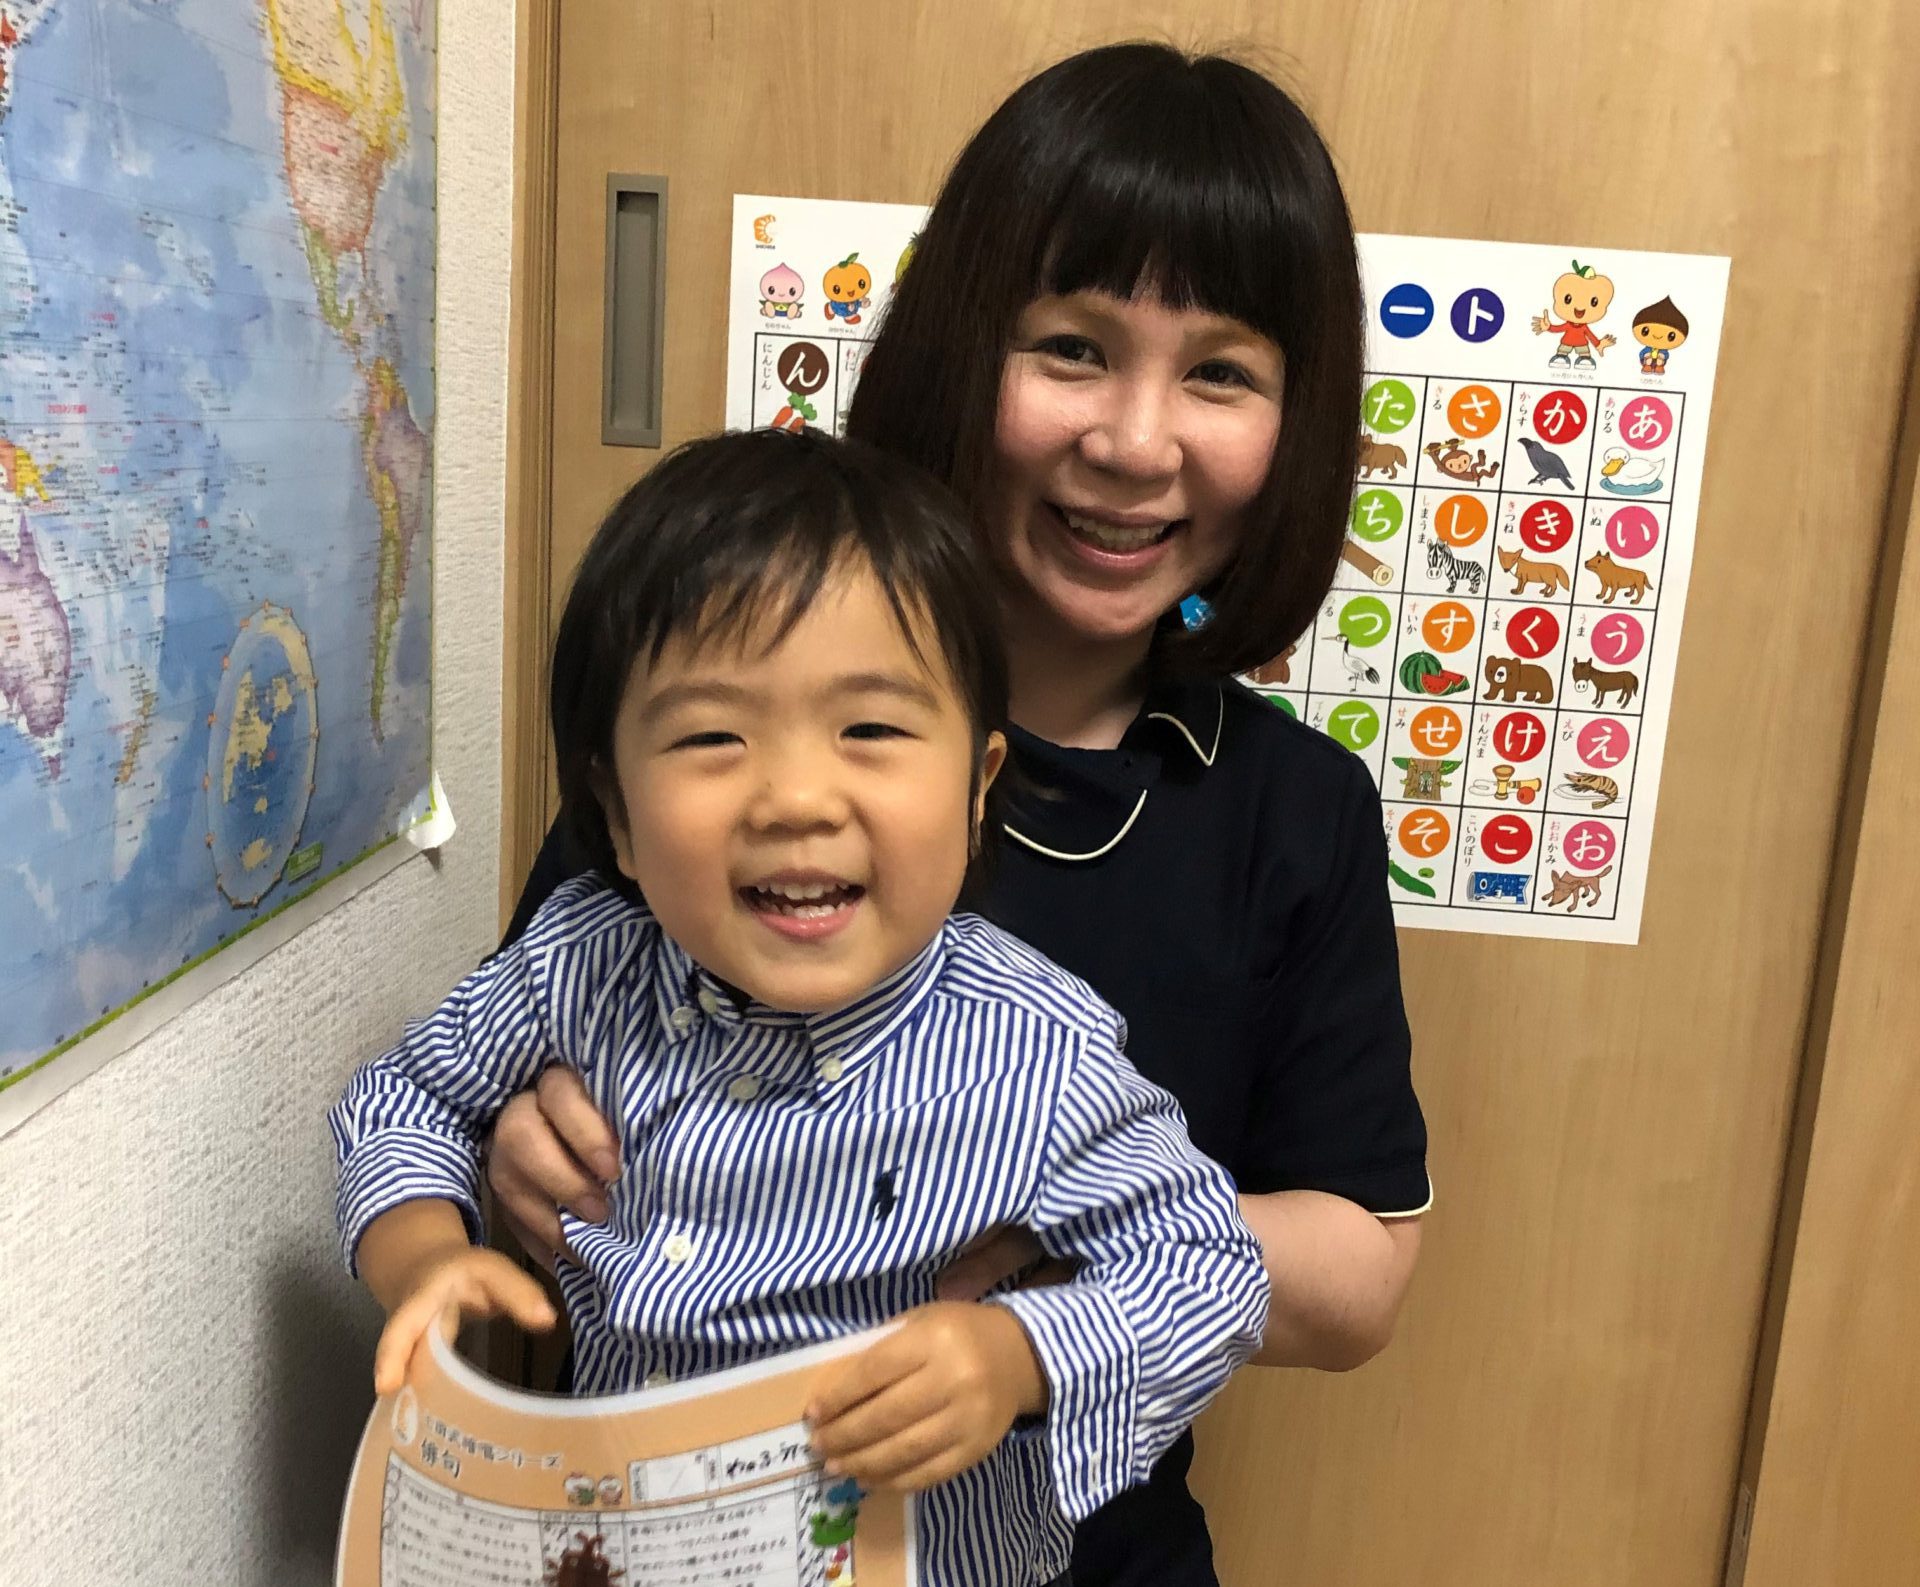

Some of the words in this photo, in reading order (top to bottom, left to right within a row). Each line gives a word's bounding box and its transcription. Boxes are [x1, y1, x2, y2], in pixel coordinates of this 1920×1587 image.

[762, 343, 772, 390] にんじん
[786, 352, 821, 387] ん
[1373, 389, 1404, 425] た
[1460, 394, 1491, 432] さ
[1517, 392, 1530, 427] からす
[1543, 399, 1581, 437] か
[1603, 397, 1615, 433] あひる
[1629, 405, 1662, 443] あ
[1363, 498, 1390, 534] ち
[1417, 495, 1429, 544] しまうま
[1451, 503, 1476, 540] し
[1504, 501, 1515, 533] きつね
[1536, 509, 1559, 546] き
[1590, 508, 1602, 526] いぬ
[1617, 520, 1650, 548] い
[1350, 614, 1382, 634] つ
[1407, 603, 1417, 635] すいか
[1432, 610, 1467, 646] す
[1492, 608, 1500, 631] くま
[1523, 616, 1540, 651] く
[1577, 614, 1586, 637] うま
[1606, 621, 1627, 657] う
[1340, 714, 1368, 742] て
[1395, 708, 1406, 728] せみ
[1420, 717, 1454, 747] せ
[1476, 712, 1488, 758] けんだま
[1562, 719, 1574, 741] えび
[1505, 722, 1537, 754] け
[1587, 726, 1618, 762] え
[1409, 817, 1441, 853] そ
[1463, 814, 1477, 867] こいのぼり
[1496, 825, 1518, 855] こ
[1544, 820, 1559, 865] おおかみ
[1572, 829, 1607, 861] お
